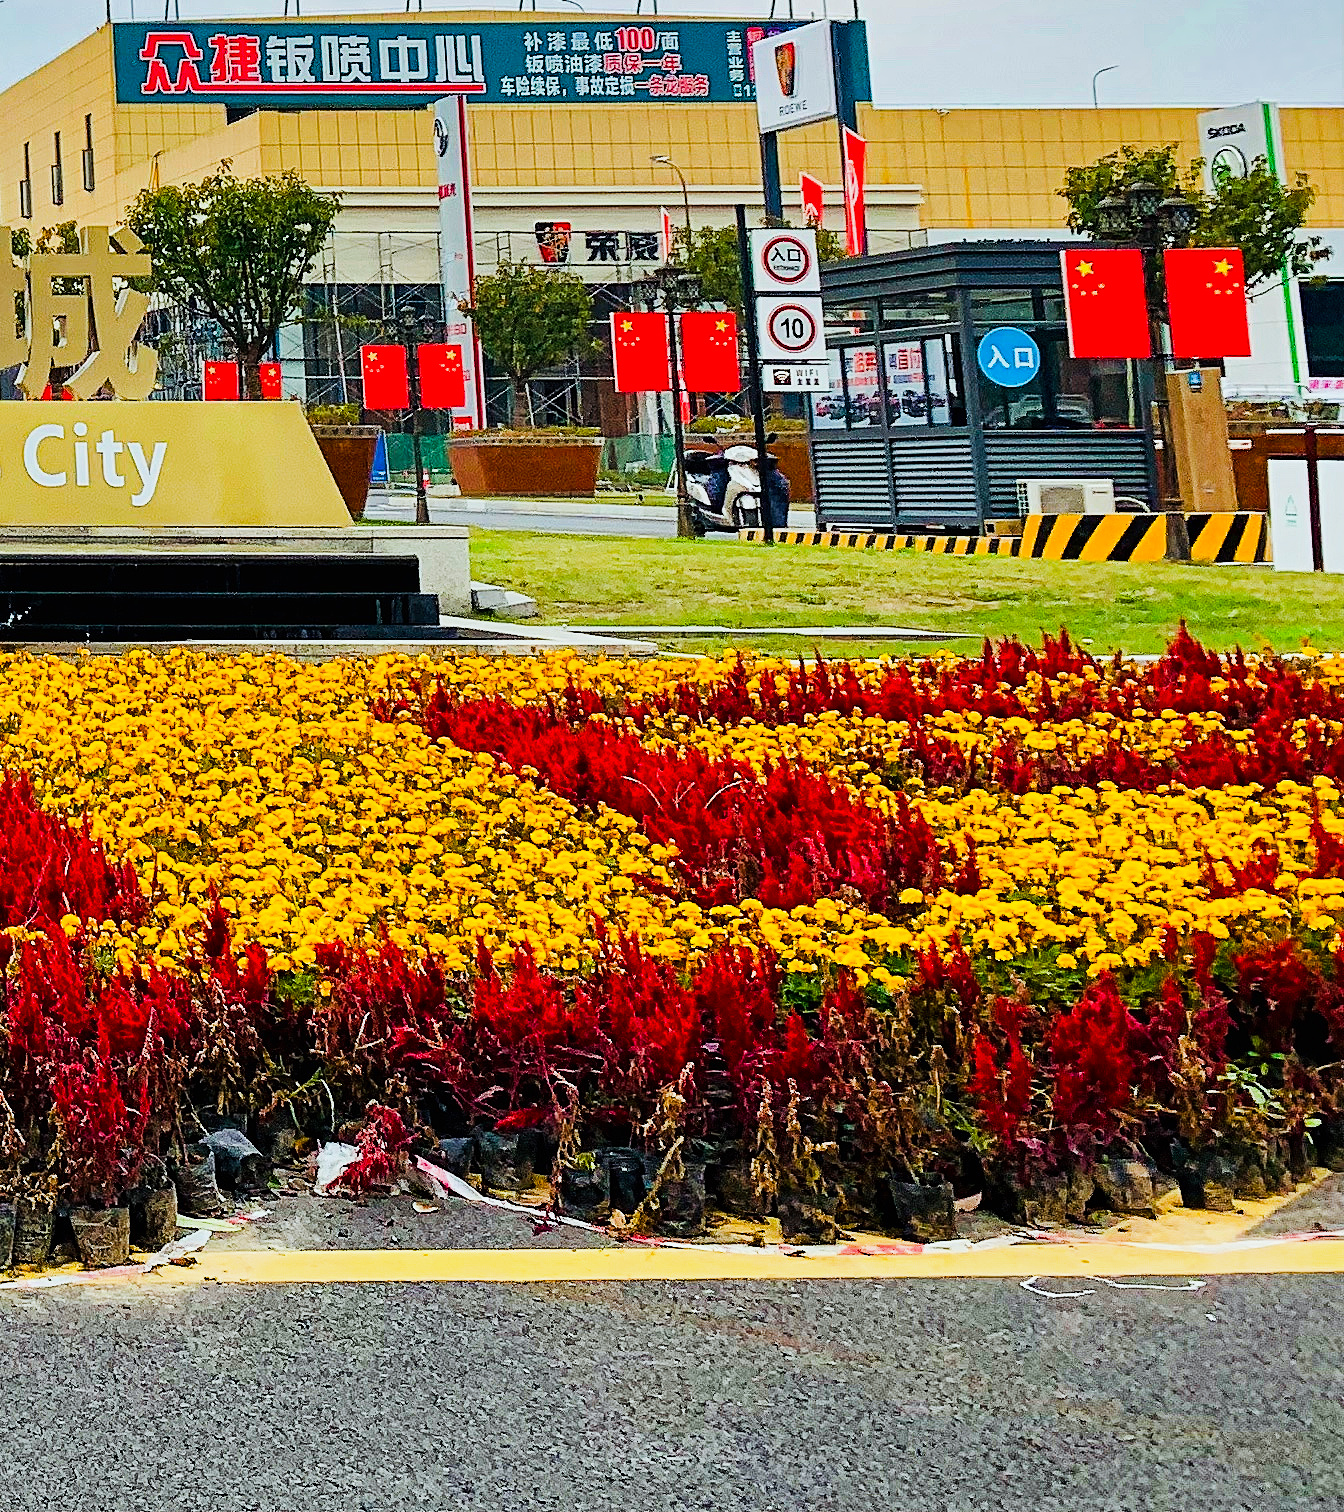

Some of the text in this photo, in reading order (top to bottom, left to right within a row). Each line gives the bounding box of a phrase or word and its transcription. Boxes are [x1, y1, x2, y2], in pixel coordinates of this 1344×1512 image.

[140, 32, 485, 93] 众捷钣喷中心
[526, 53, 682, 74] 钣喷油漆质保一年
[771, 247, 801, 262] 入口
[780, 318, 804, 338] 10
[987, 344, 1034, 369] 入口
[23, 422, 168, 507] City
